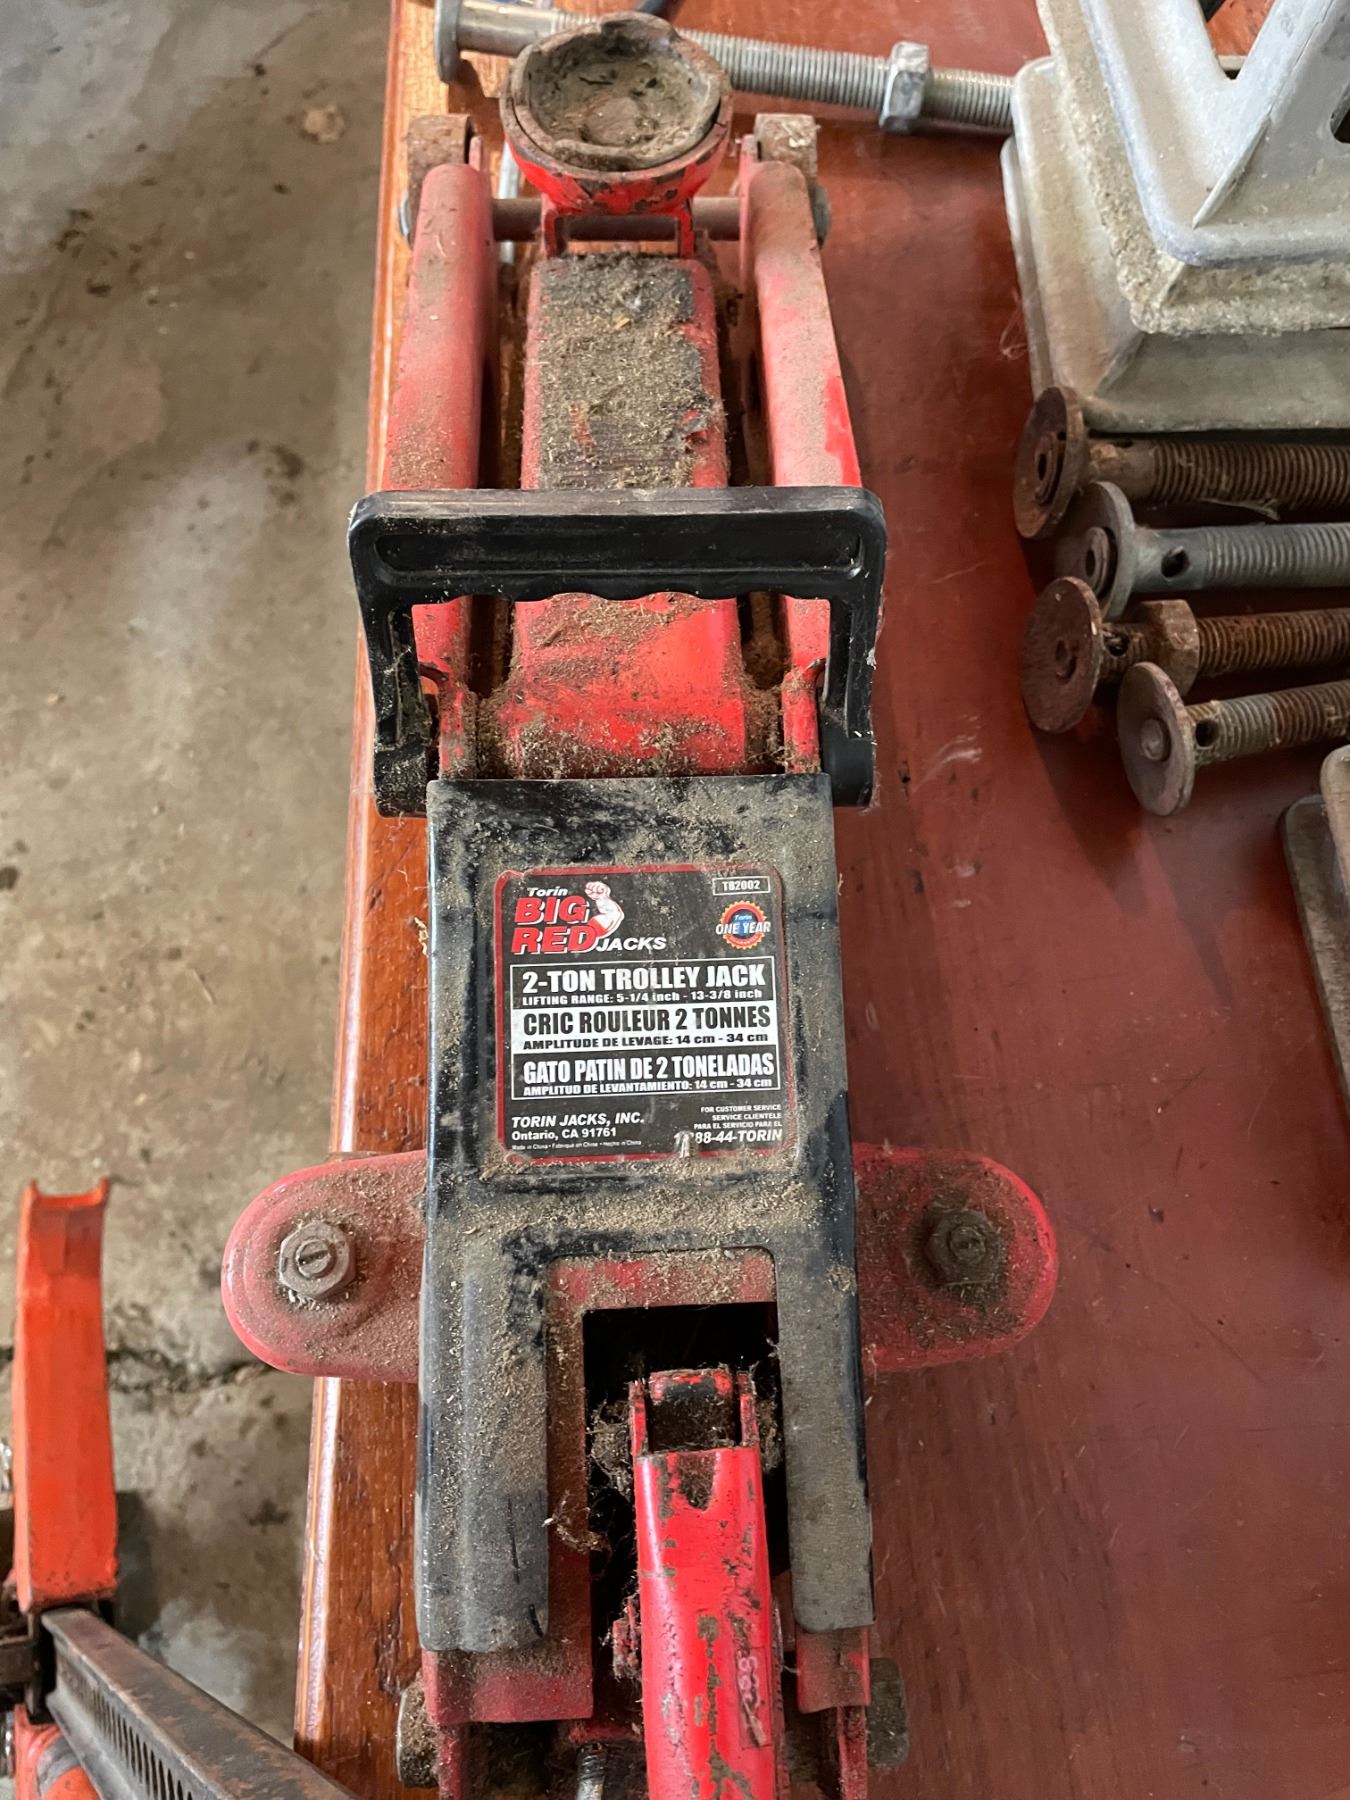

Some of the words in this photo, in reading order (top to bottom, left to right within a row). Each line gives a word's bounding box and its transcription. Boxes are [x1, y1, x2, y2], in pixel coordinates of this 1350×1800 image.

[527, 886, 568, 897] Torin
[514, 896, 590, 925] BIG
[715, 923, 740, 935] ONE
[743, 921, 771, 934] YEAR
[511, 925, 598, 955] RED
[597, 937, 667, 952] JACKS
[522, 970, 596, 993] 2-TON
[601, 966, 700, 990] TROLLEY
[705, 964, 766, 988] JACK
[522, 995, 568, 1006] LIFTING
[571, 993, 613, 1004] RANGE:
[616, 992, 649, 1003] 5-1/4
[652, 991, 680, 1001] inch
[691, 989, 731, 1000] 13-3/8
[734, 988, 762, 999] inch
[523, 1012, 574, 1036] CRIC
[579, 1009, 670, 1034] ROULEUR
[675, 1008, 688, 1030] 2
[692, 1005, 771, 1029] TONNES
[523, 1038, 599, 1050] AMPLITUDE
[602, 1037, 619, 1047] DE
[622, 1035, 673, 1047] LEVAGE:
[676, 1035, 691, 1044] 14
[694, 1035, 715, 1044] cm
[726, 1033, 744, 1043] 34
[747, 1033, 768, 1042] cm
[523, 1060, 571, 1084] GATO
[575, 1058, 626, 1082] PATIN
[630, 1057, 653, 1080] DE
[656, 1056, 668, 1079] 2
[671, 1053, 775, 1079] TONELADAS
[523, 1085, 581, 1096] AMPLITUD
[583, 1084, 598, 1094] DE
[600, 1080, 693, 1093] LEVANTAMIENTO:
[694, 1080, 708, 1090] 14
[709, 1080, 728, 1089] cm
[736, 1078, 752, 1088] 34
[753, 1079, 772, 1088] cm
[715, 1105, 752, 1113] CUSTOMER
[511, 1115, 557, 1129] TORIN
[559, 1112, 611, 1128] JACKS,
[614, 1112, 645, 1124] INC.
[511, 1130, 559, 1141] Ontario,
[561, 1128, 579, 1139] CA
[582, 1127, 617, 1138] 91761
